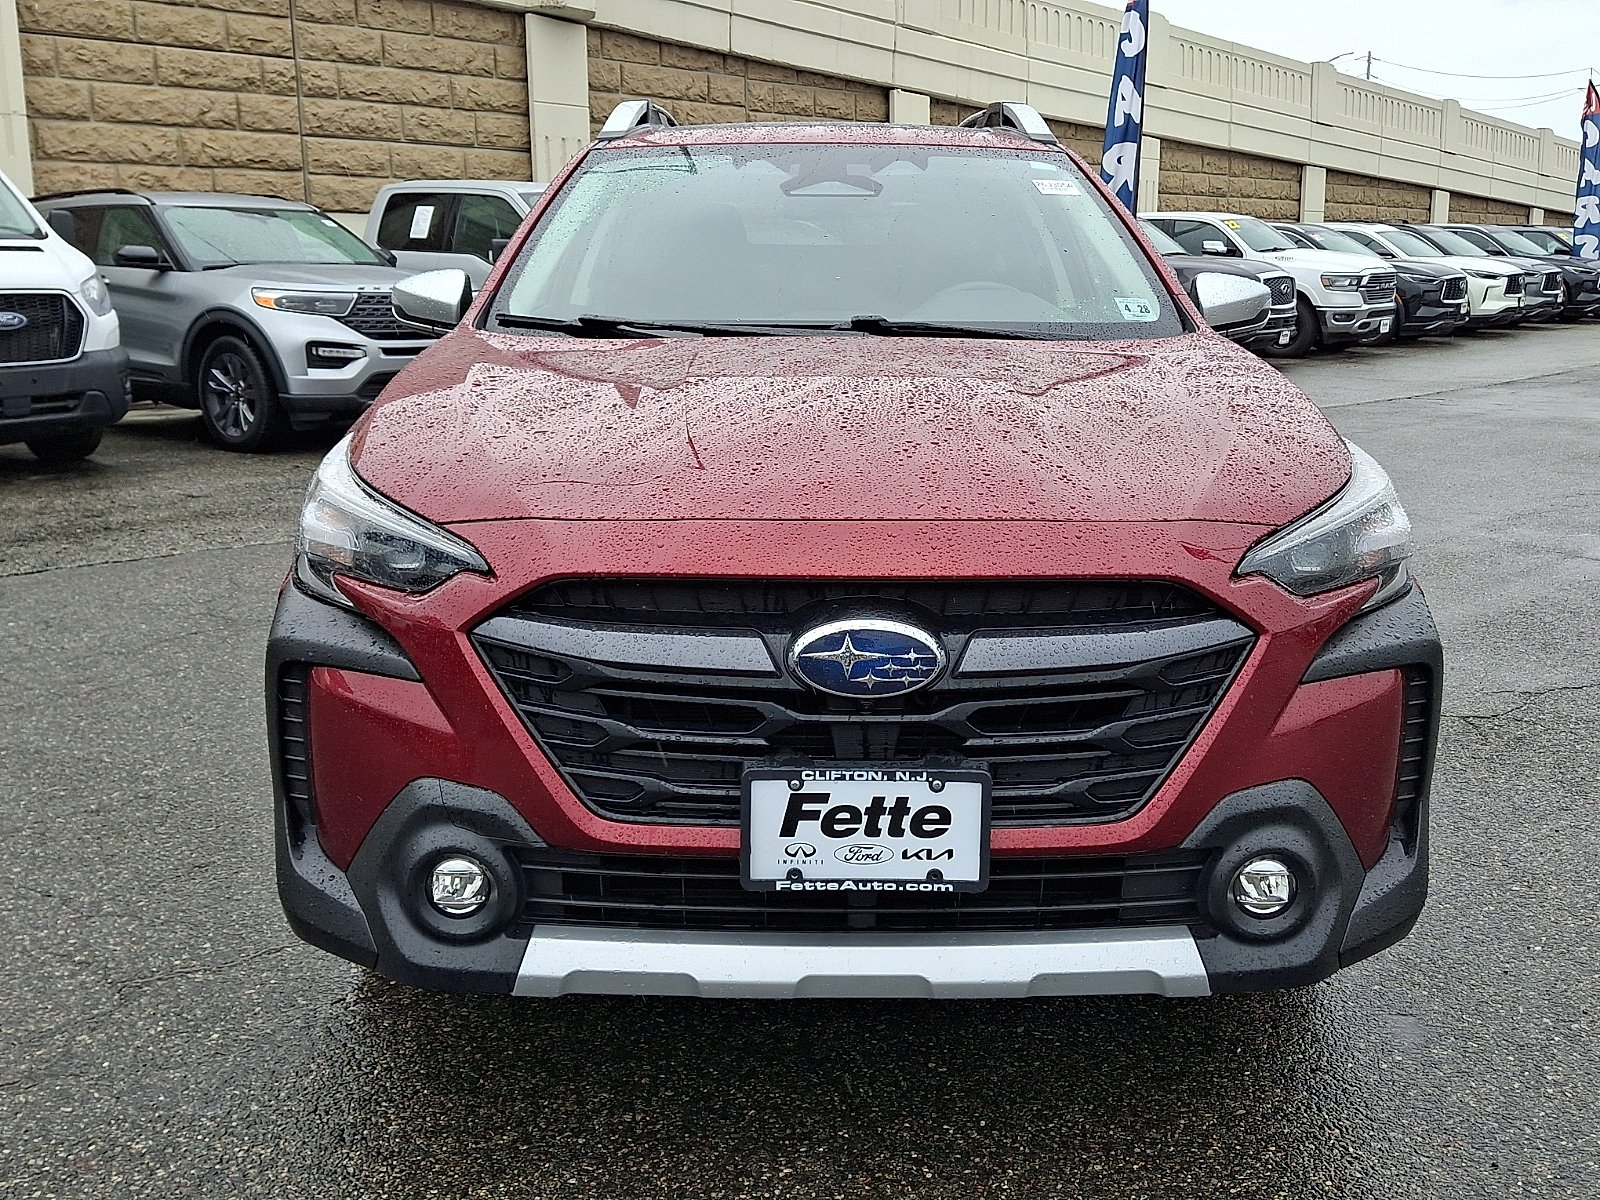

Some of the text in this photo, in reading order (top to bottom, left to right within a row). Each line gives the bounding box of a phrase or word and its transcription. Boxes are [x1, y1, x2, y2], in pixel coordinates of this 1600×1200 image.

[1124, 303, 1151, 314] 4 28
[801, 770, 933, 782] CLIFTON, N.J.
[779, 792, 952, 839] Fette
[843, 846, 883, 862] Ford
[901, 848, 954, 861] KIA
[777, 858, 825, 866] INFINITI
[775, 880, 954, 892] FetteAuto.com
